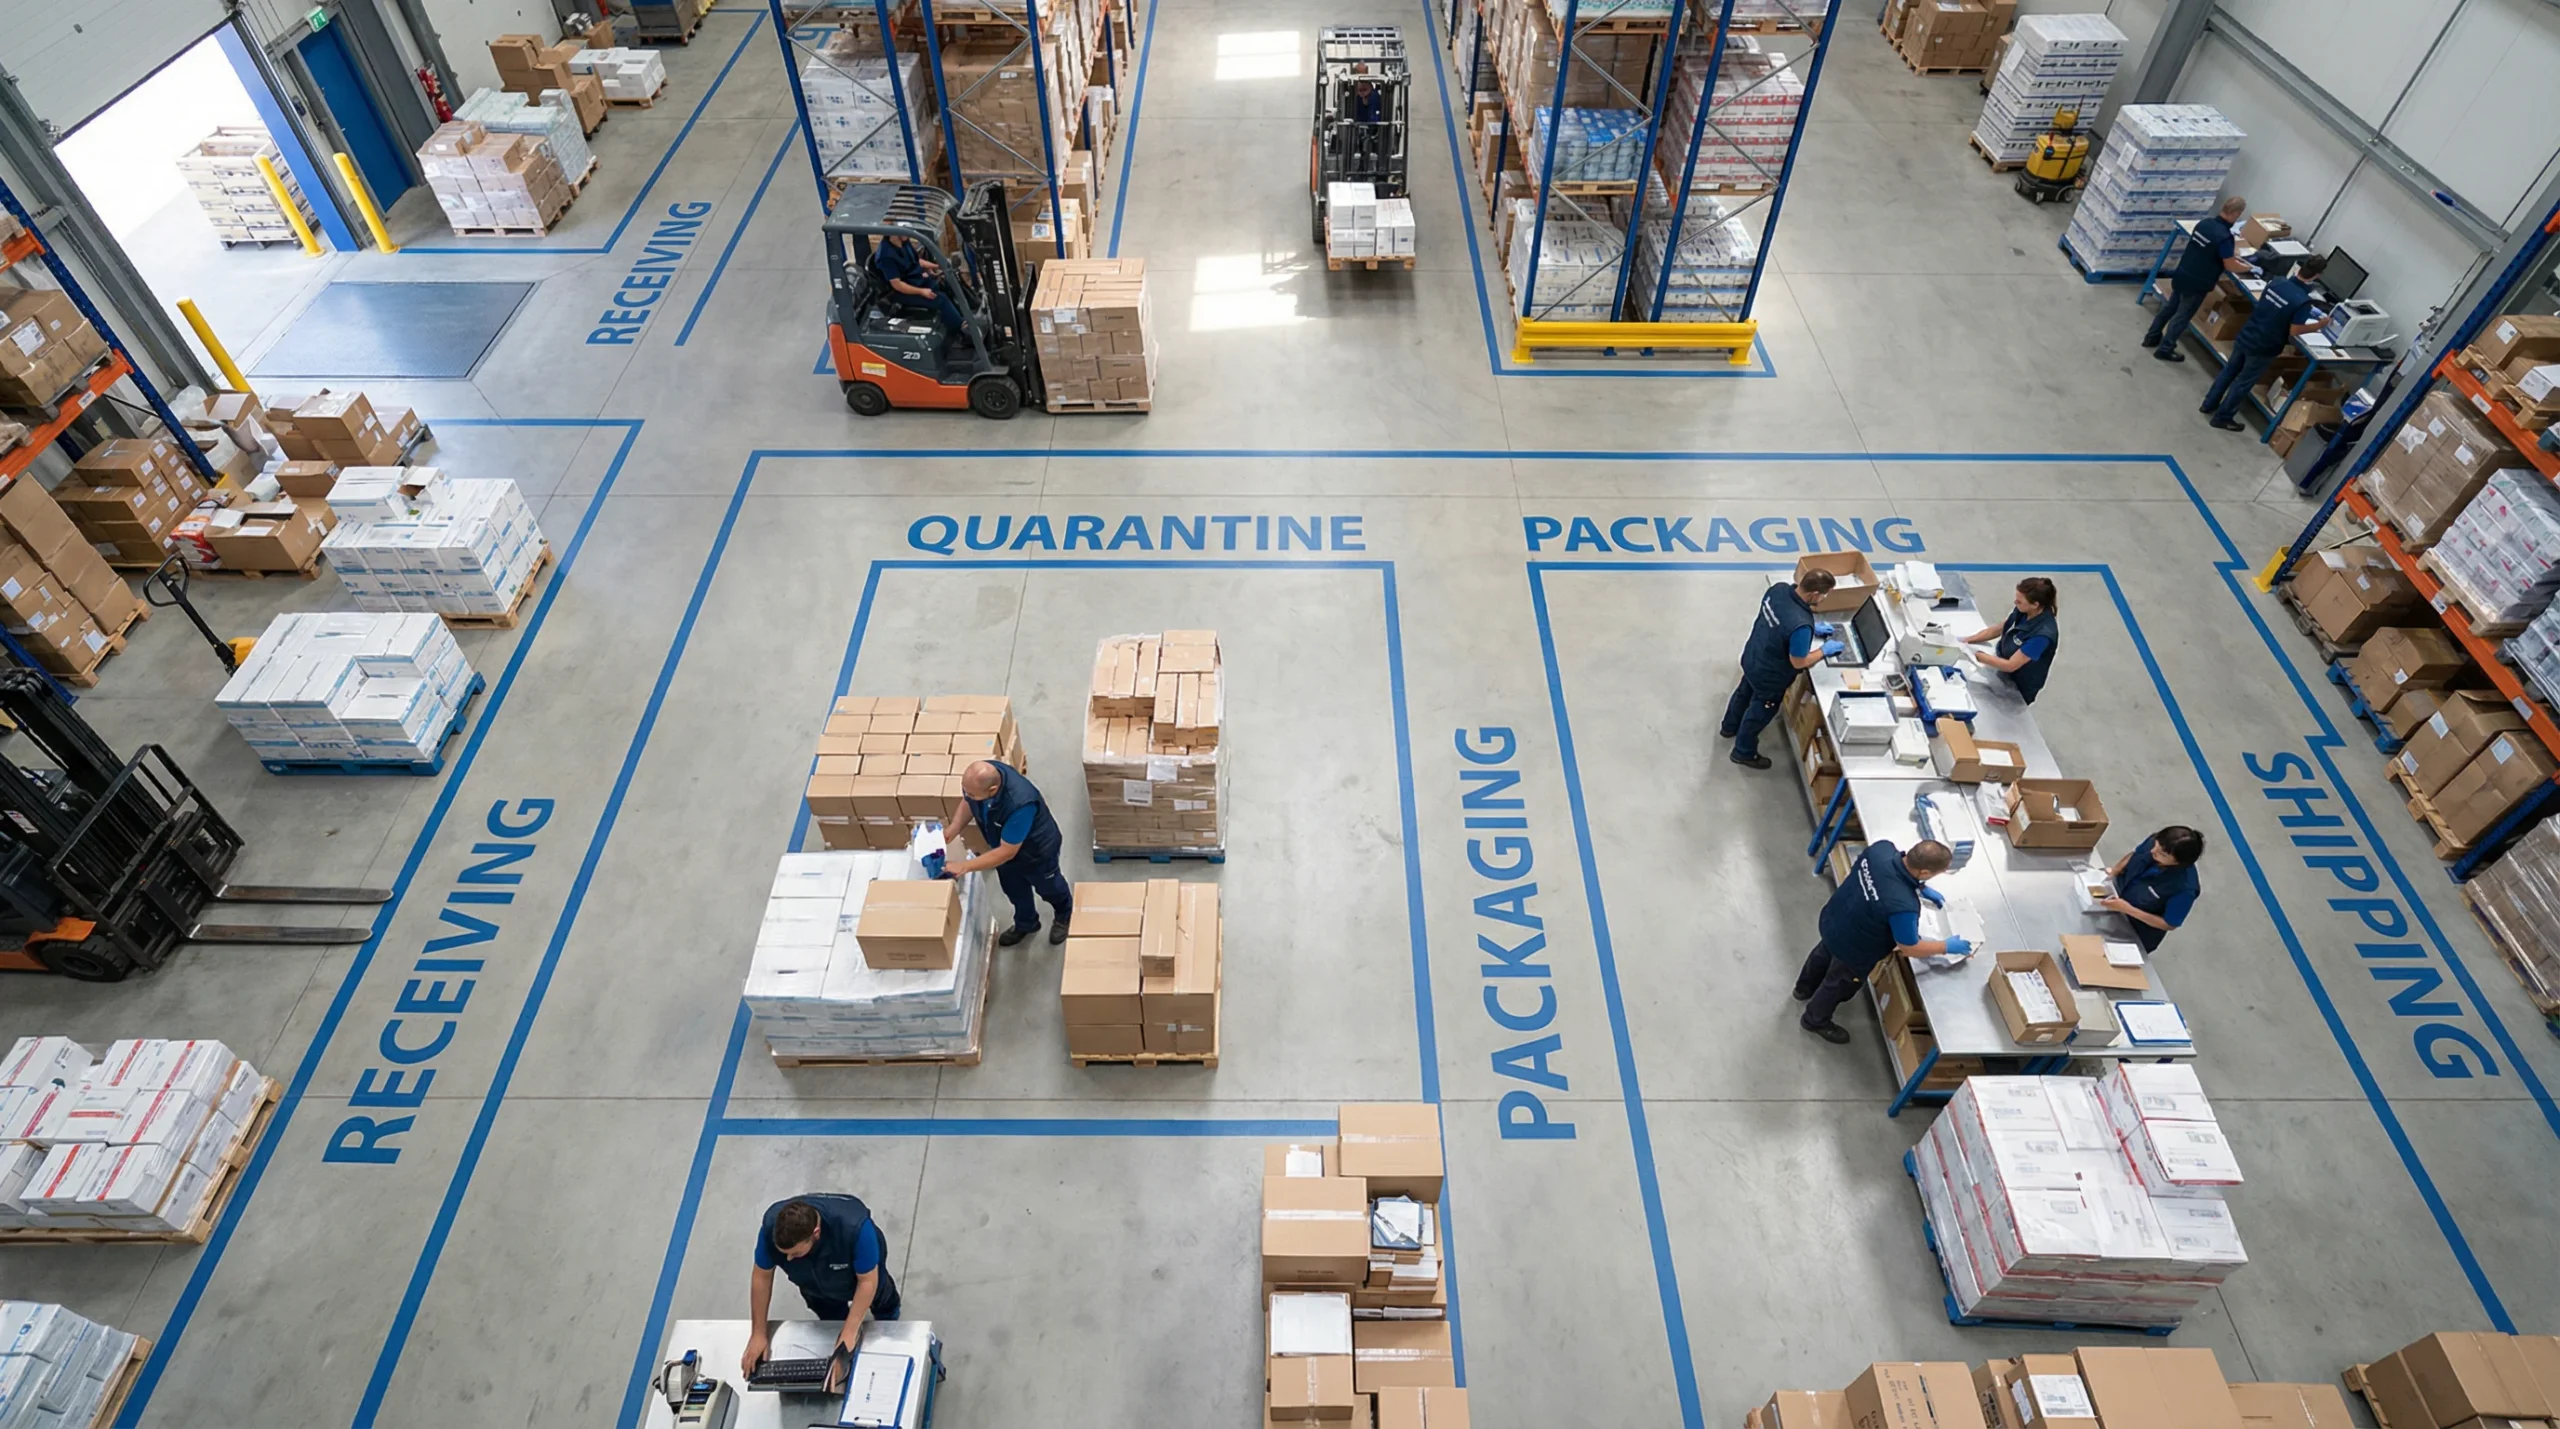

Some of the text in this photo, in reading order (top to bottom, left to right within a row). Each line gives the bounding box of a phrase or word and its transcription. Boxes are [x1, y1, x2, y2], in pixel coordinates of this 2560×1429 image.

[585, 201, 713, 345] RECEIVING
[906, 514, 1366, 556] QUARANTINE
[1521, 515, 1926, 553] PACKAGING
[321, 797, 556, 1166] RECEIVING
[1453, 726, 1577, 1141] PACKAGING
[2241, 750, 2501, 1080] SHIPPING
